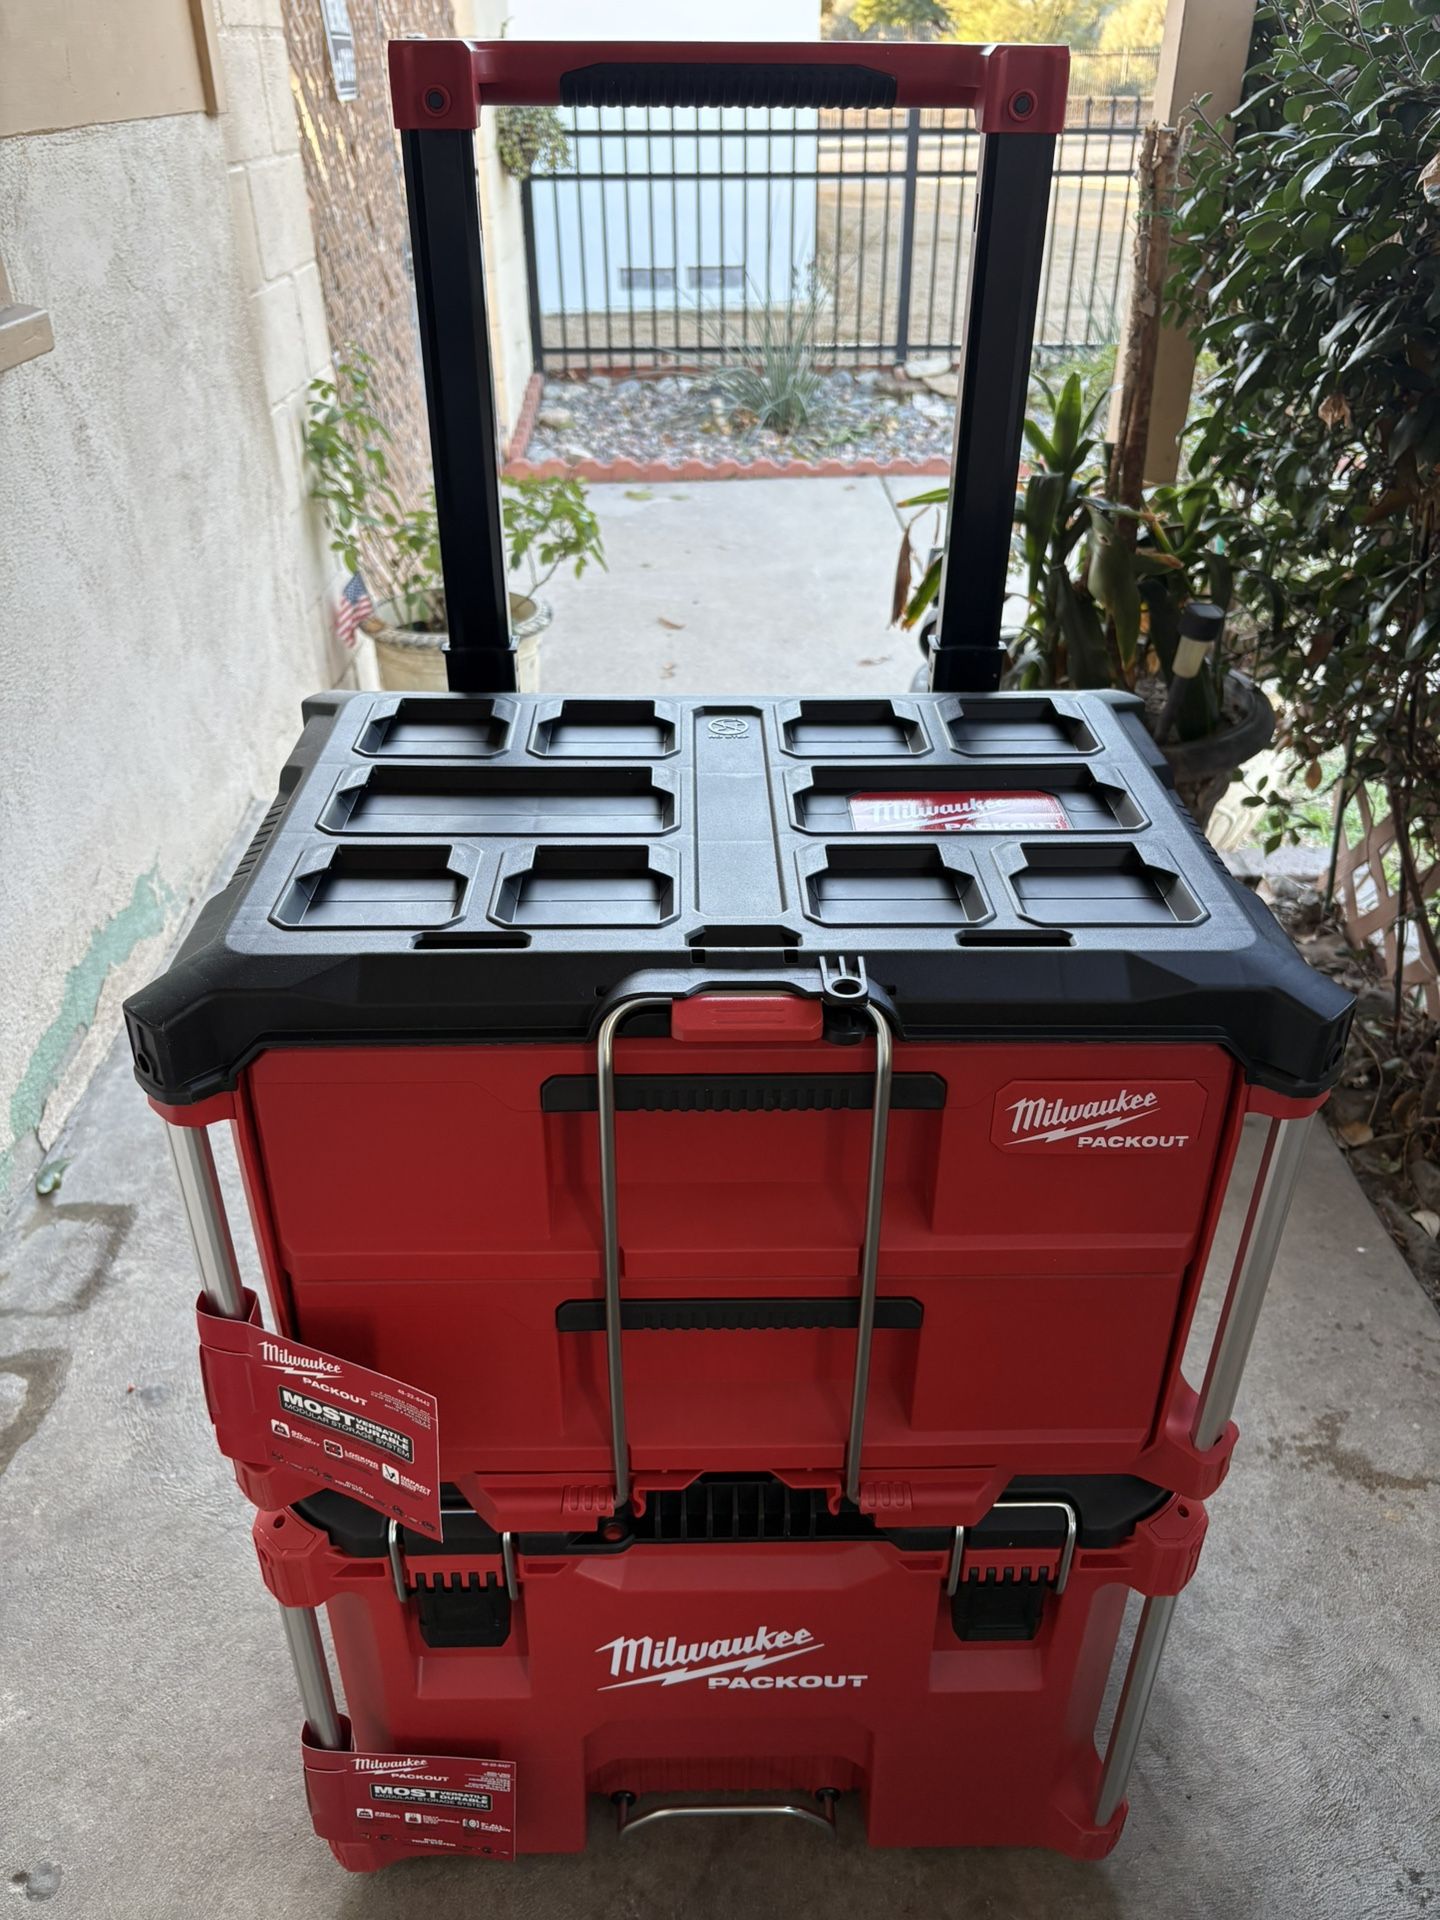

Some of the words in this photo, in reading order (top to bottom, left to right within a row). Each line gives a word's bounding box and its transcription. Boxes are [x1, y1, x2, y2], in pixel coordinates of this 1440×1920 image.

[866, 797, 1009, 823] Milwaukee
[1005, 1089, 1158, 1134] Milwaukee
[1077, 1135, 1189, 1148] PACKOUT
[257, 1340, 342, 1374] Milwaukee
[302, 1376, 368, 1406] PACKOUT
[282, 1390, 355, 1427] MOST
[284, 1402, 330, 1424] MODULAR
[331, 1420, 374, 1441] STORAGE
[375, 1438, 410, 1459] SYSTEM
[355, 1417, 410, 1444] VERSATILE
[355, 1424, 410, 1451] DURABLE
[595, 1626, 814, 1677] Milwaukee
[708, 1675, 868, 1689] PACKOUT
[351, 1758, 428, 1771] Milwaukee
[391, 1773, 450, 1783] PACKOUT
[374, 1786, 440, 1799] MOST
[417, 1797, 455, 1805] STORAGE
[455, 1801, 489, 1809] SYSTEM
[440, 1791, 489, 1800] VERSATILE
[440, 1795, 489, 1804] DURABLE
